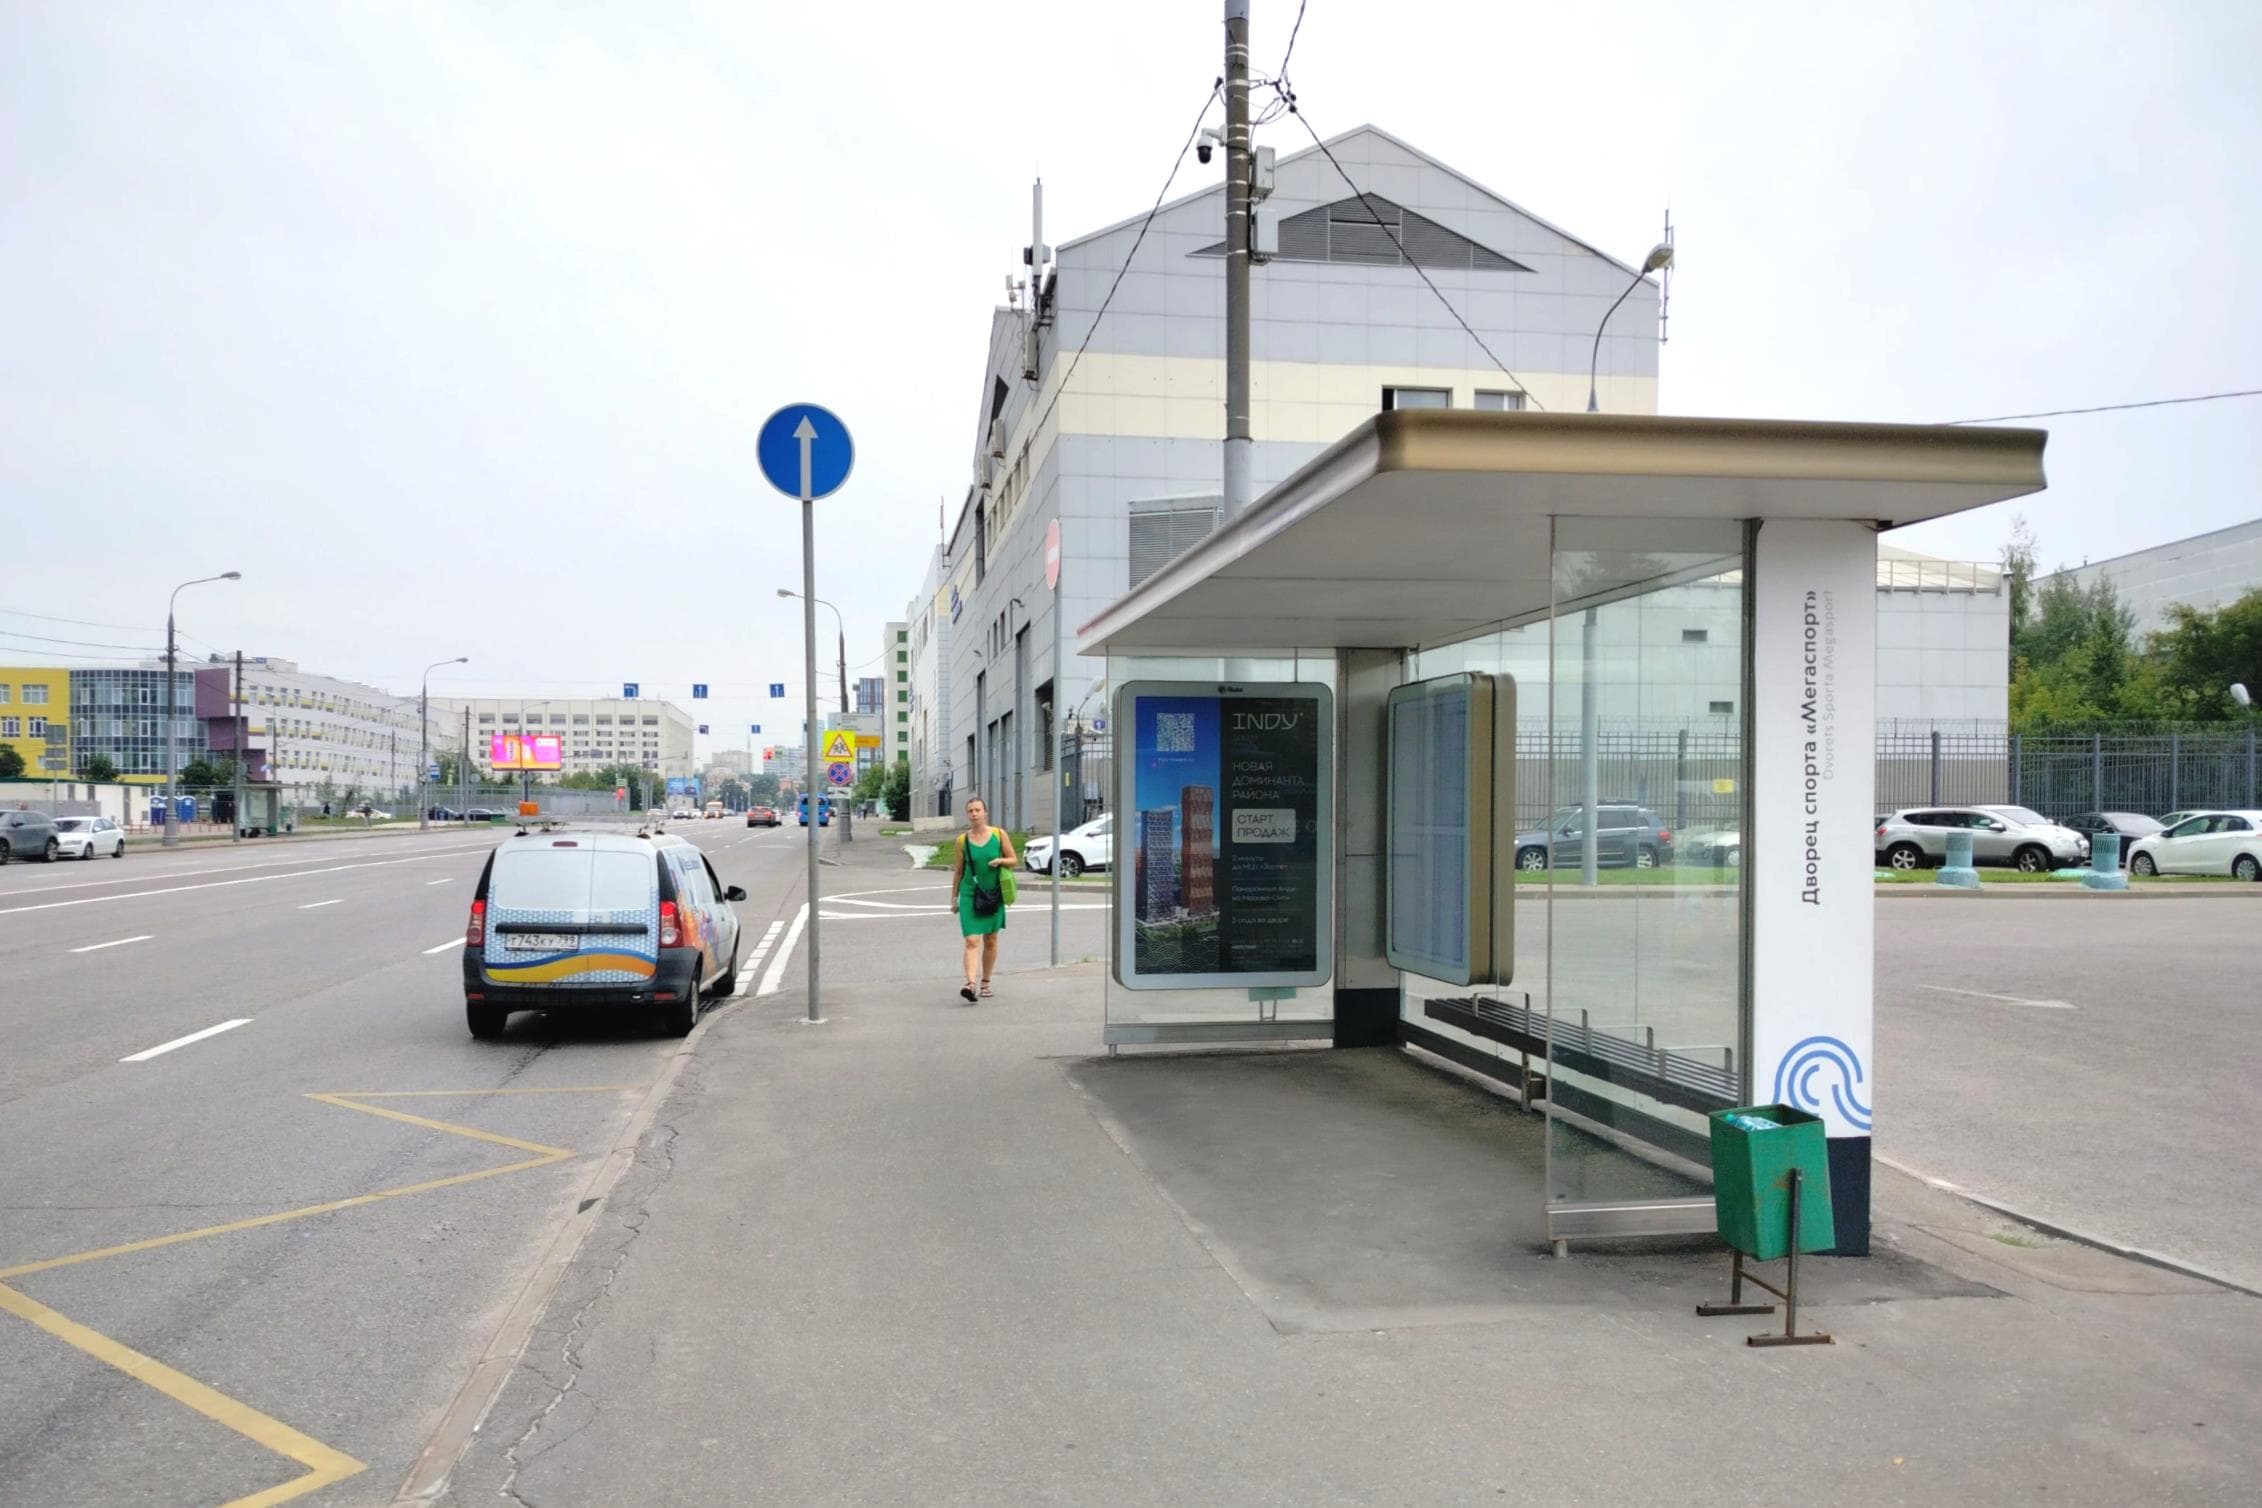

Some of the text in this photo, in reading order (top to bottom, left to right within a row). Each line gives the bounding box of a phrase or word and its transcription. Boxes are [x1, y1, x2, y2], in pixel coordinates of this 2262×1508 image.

[1823, 590, 1838, 780] Dvorets Sporta Megasport
[1232, 713, 1297, 730] INDY
[1800, 590, 1821, 905] Дворец спорта «Мегаспорт»
[1232, 761, 1273, 772] НОВАЯ
[1232, 775, 1305, 786] ДОМИНАНТА
[1232, 789, 1280, 800] РАЙОНА
[1237, 814, 1274, 825] СТАРТ
[1237, 827, 1290, 838] ПРОДАЖ
